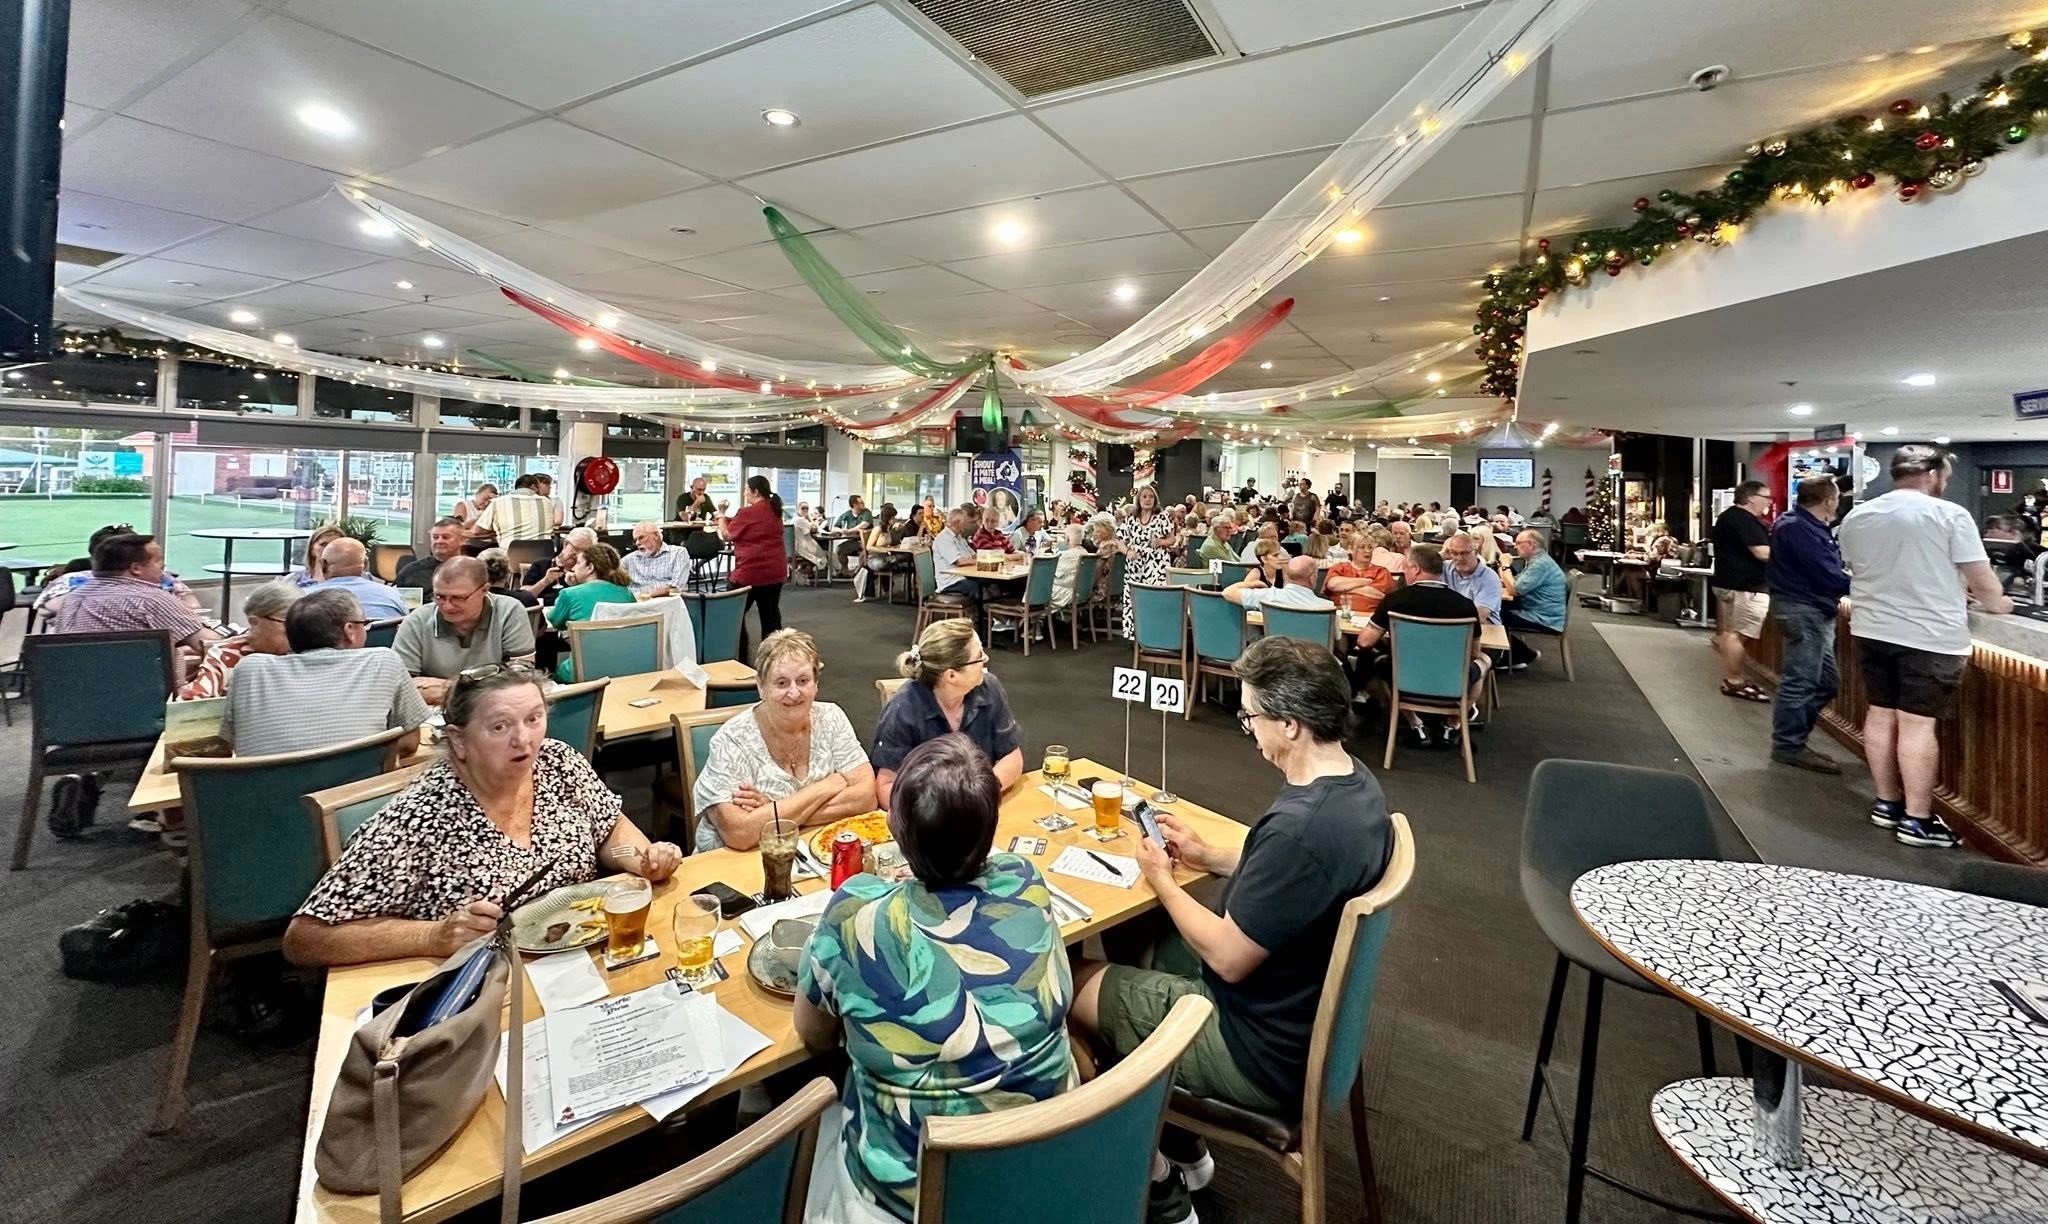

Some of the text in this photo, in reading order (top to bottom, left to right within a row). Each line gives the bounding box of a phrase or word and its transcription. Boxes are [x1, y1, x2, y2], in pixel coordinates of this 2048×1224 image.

[974, 460, 995, 469] SHOUT
[973, 476, 979, 484] A
[1118, 674, 1141, 695] 22
[1156, 683, 1179, 706] 20
